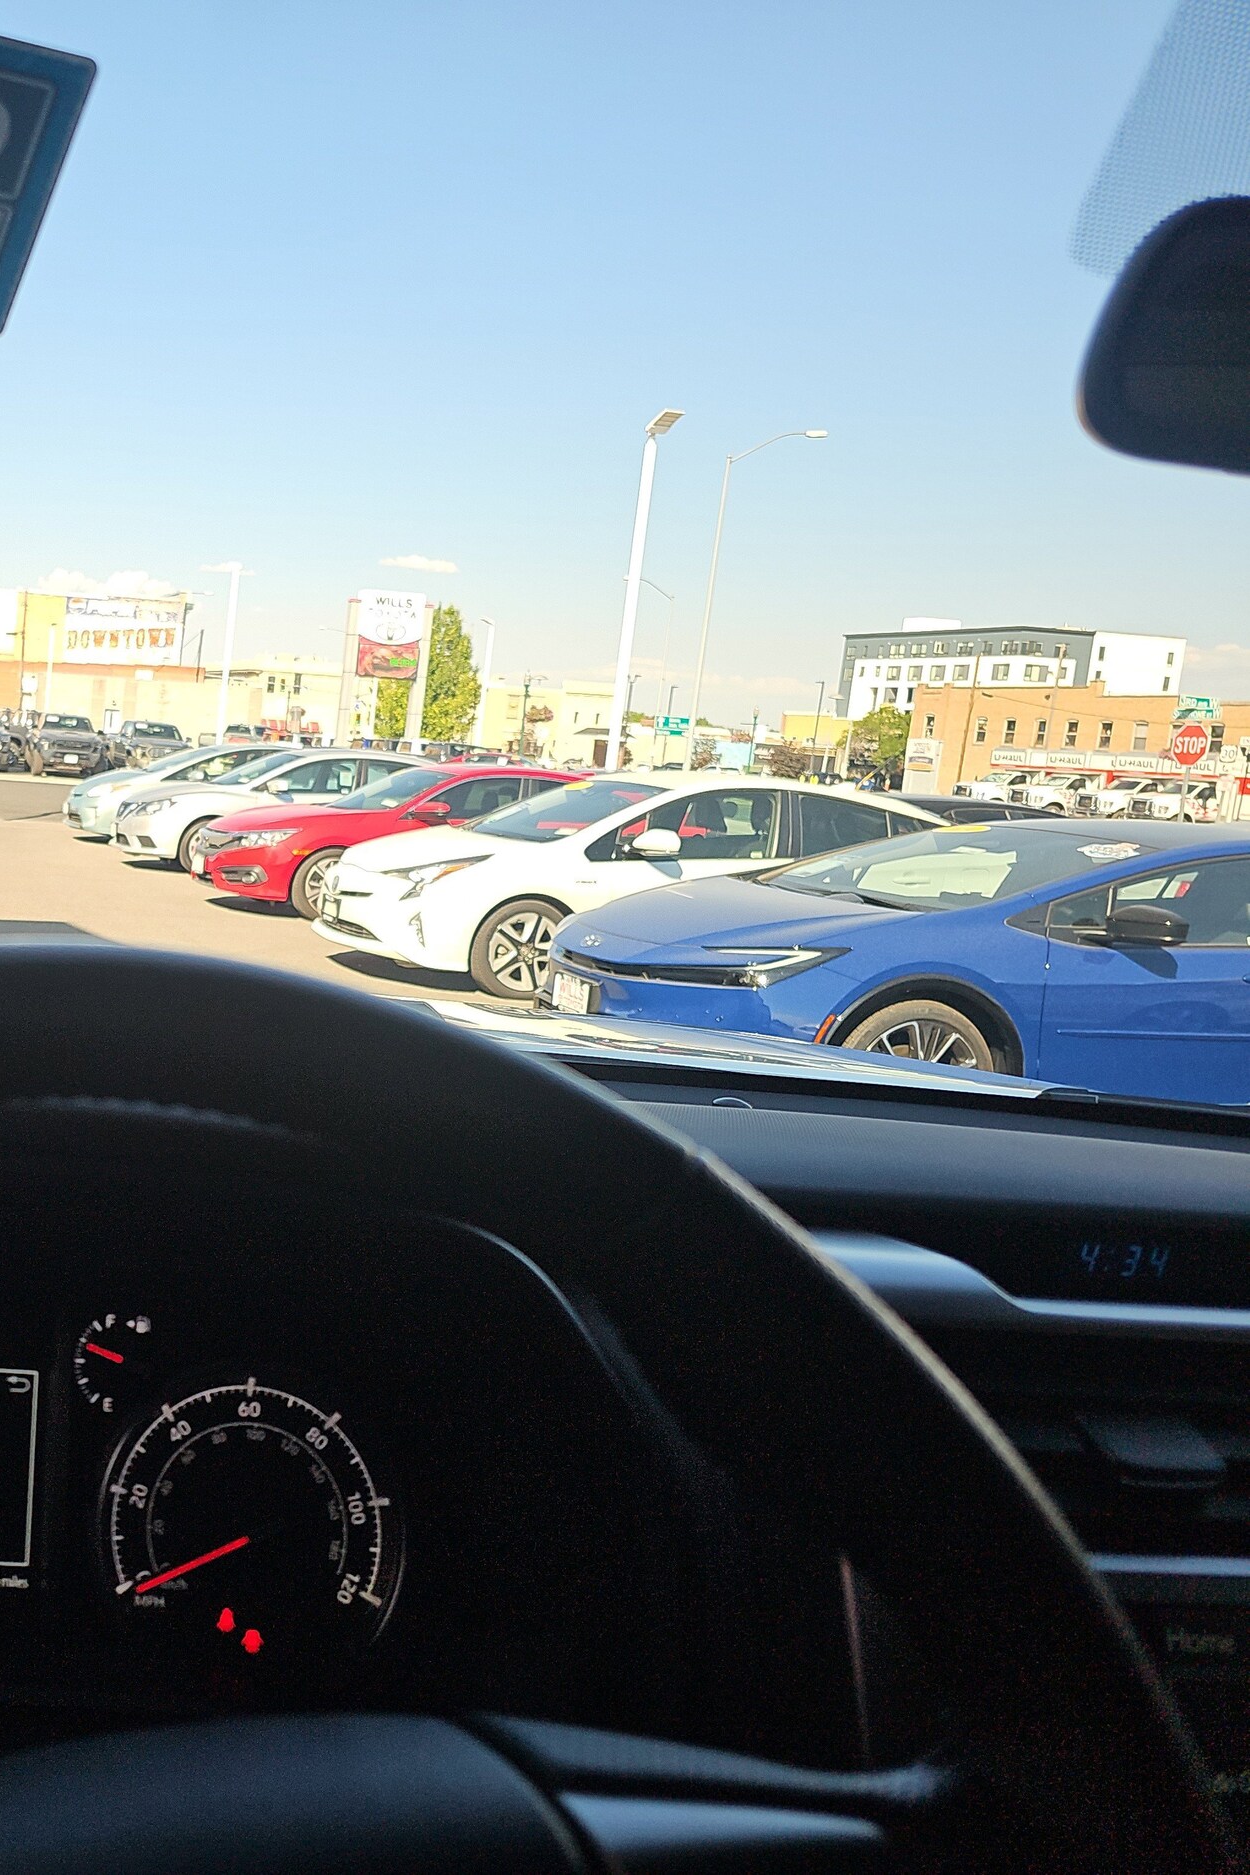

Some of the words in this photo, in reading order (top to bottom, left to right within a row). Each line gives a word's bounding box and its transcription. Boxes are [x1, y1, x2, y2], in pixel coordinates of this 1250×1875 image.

[376, 597, 413, 609] WILLS
[67, 627, 176, 650] DOWNTOWN
[1174, 736, 1206, 754] STOP
[994, 754, 1023, 763] U-HAUL
[1050, 756, 1083, 765] U-HAUL
[1119, 759, 1154, 769] U-HAUL
[1175, 762, 1212, 771] UAUL
[1080, 1241, 1170, 1278] 4:34
[237, 1401, 262, 1418] 60
[170, 1420, 192, 1441] 40
[305, 1426, 329, 1450] 80
[128, 1484, 148, 1510] 20
[347, 1491, 367, 1525] 100
[336, 1573, 362, 1605] 120
